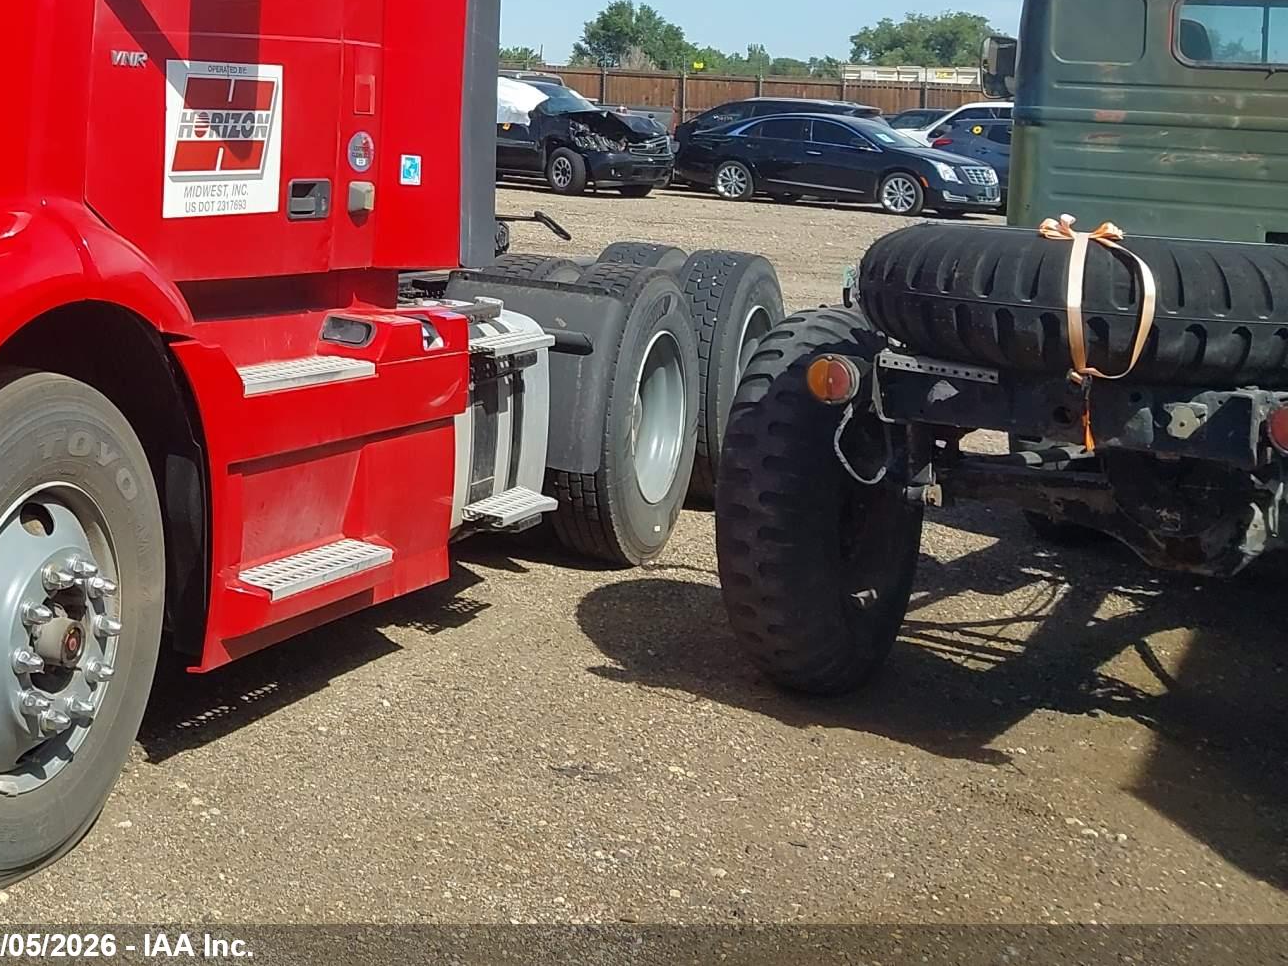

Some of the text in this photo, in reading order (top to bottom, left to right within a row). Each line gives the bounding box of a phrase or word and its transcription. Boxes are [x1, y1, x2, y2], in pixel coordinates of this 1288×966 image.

[110, 49, 148, 68] VNR
[207, 64, 238, 75] OPERATED
[177, 112, 271, 139] HORIZON
[183, 183, 249, 199] MIDWEST, INC.
[185, 201, 197, 213] US
[198, 200, 215, 213] DOT
[38, 427, 139, 501] TOYO
